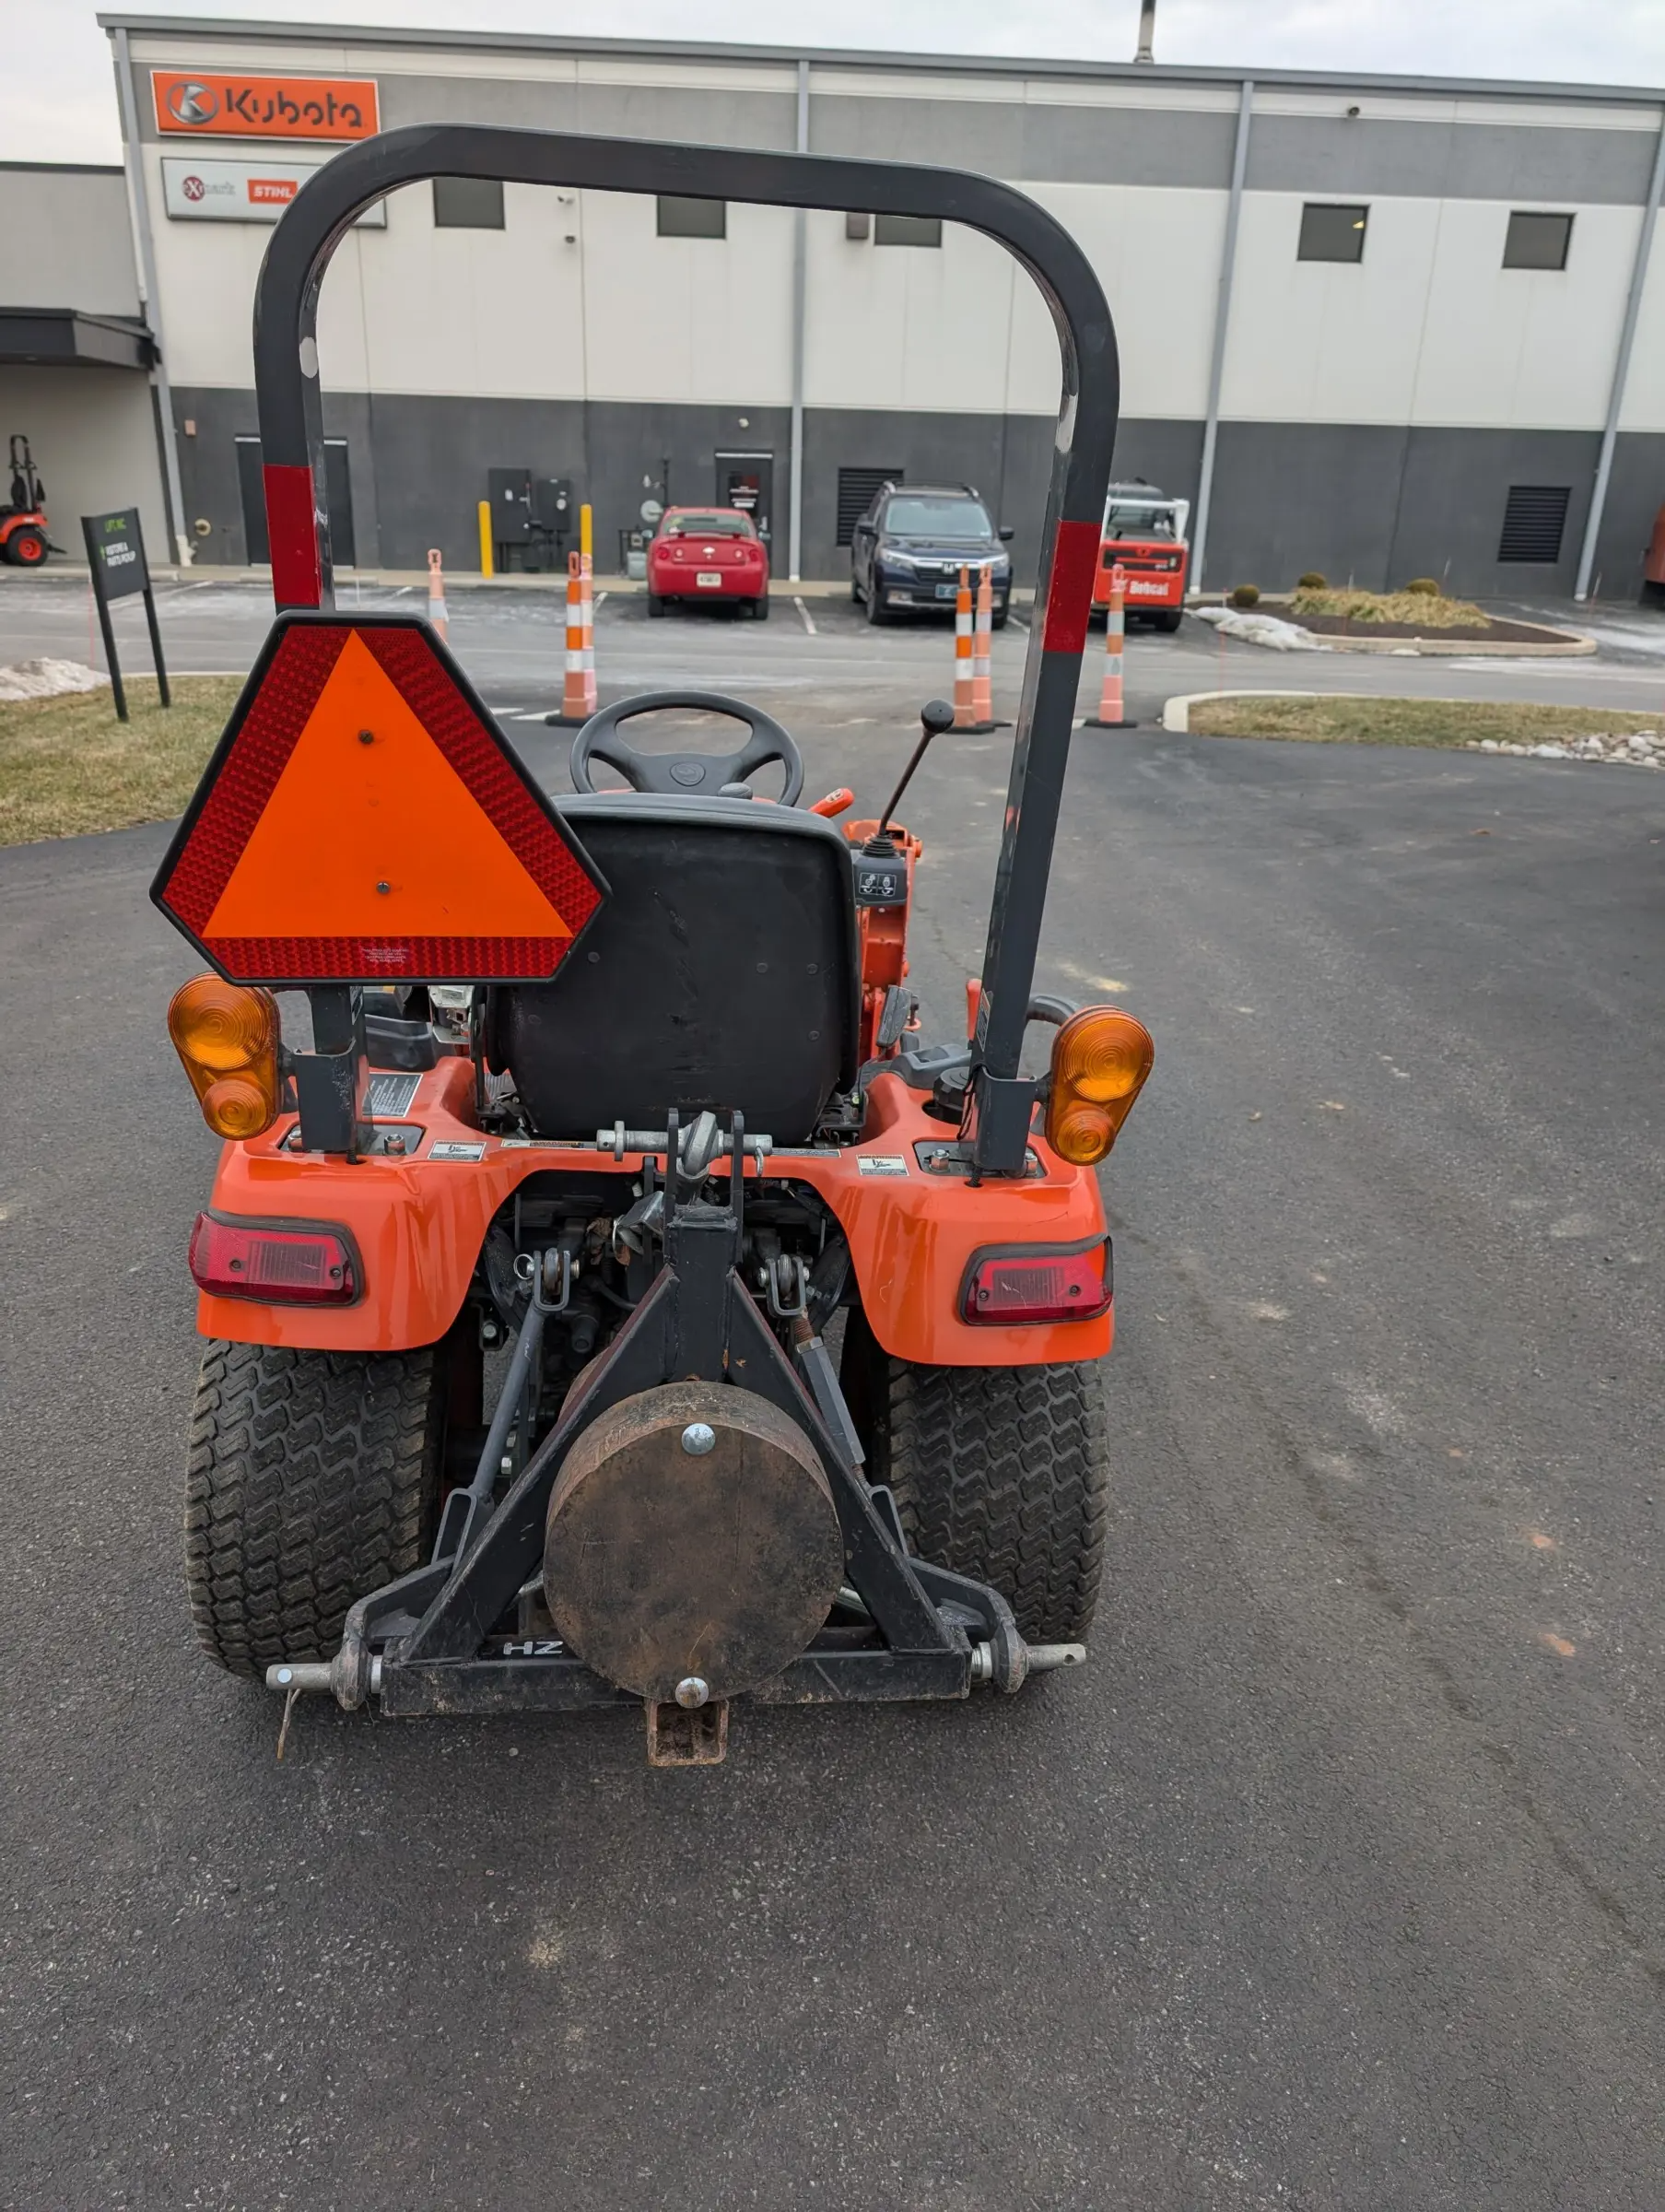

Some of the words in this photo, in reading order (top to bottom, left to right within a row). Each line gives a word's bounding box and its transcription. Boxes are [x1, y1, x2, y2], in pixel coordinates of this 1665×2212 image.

[226, 88, 362, 127] Kubota
[253, 185, 293, 199] STIHL
[1130, 581, 1169, 596] Bobcat
[503, 1641, 563, 1654] HZ
